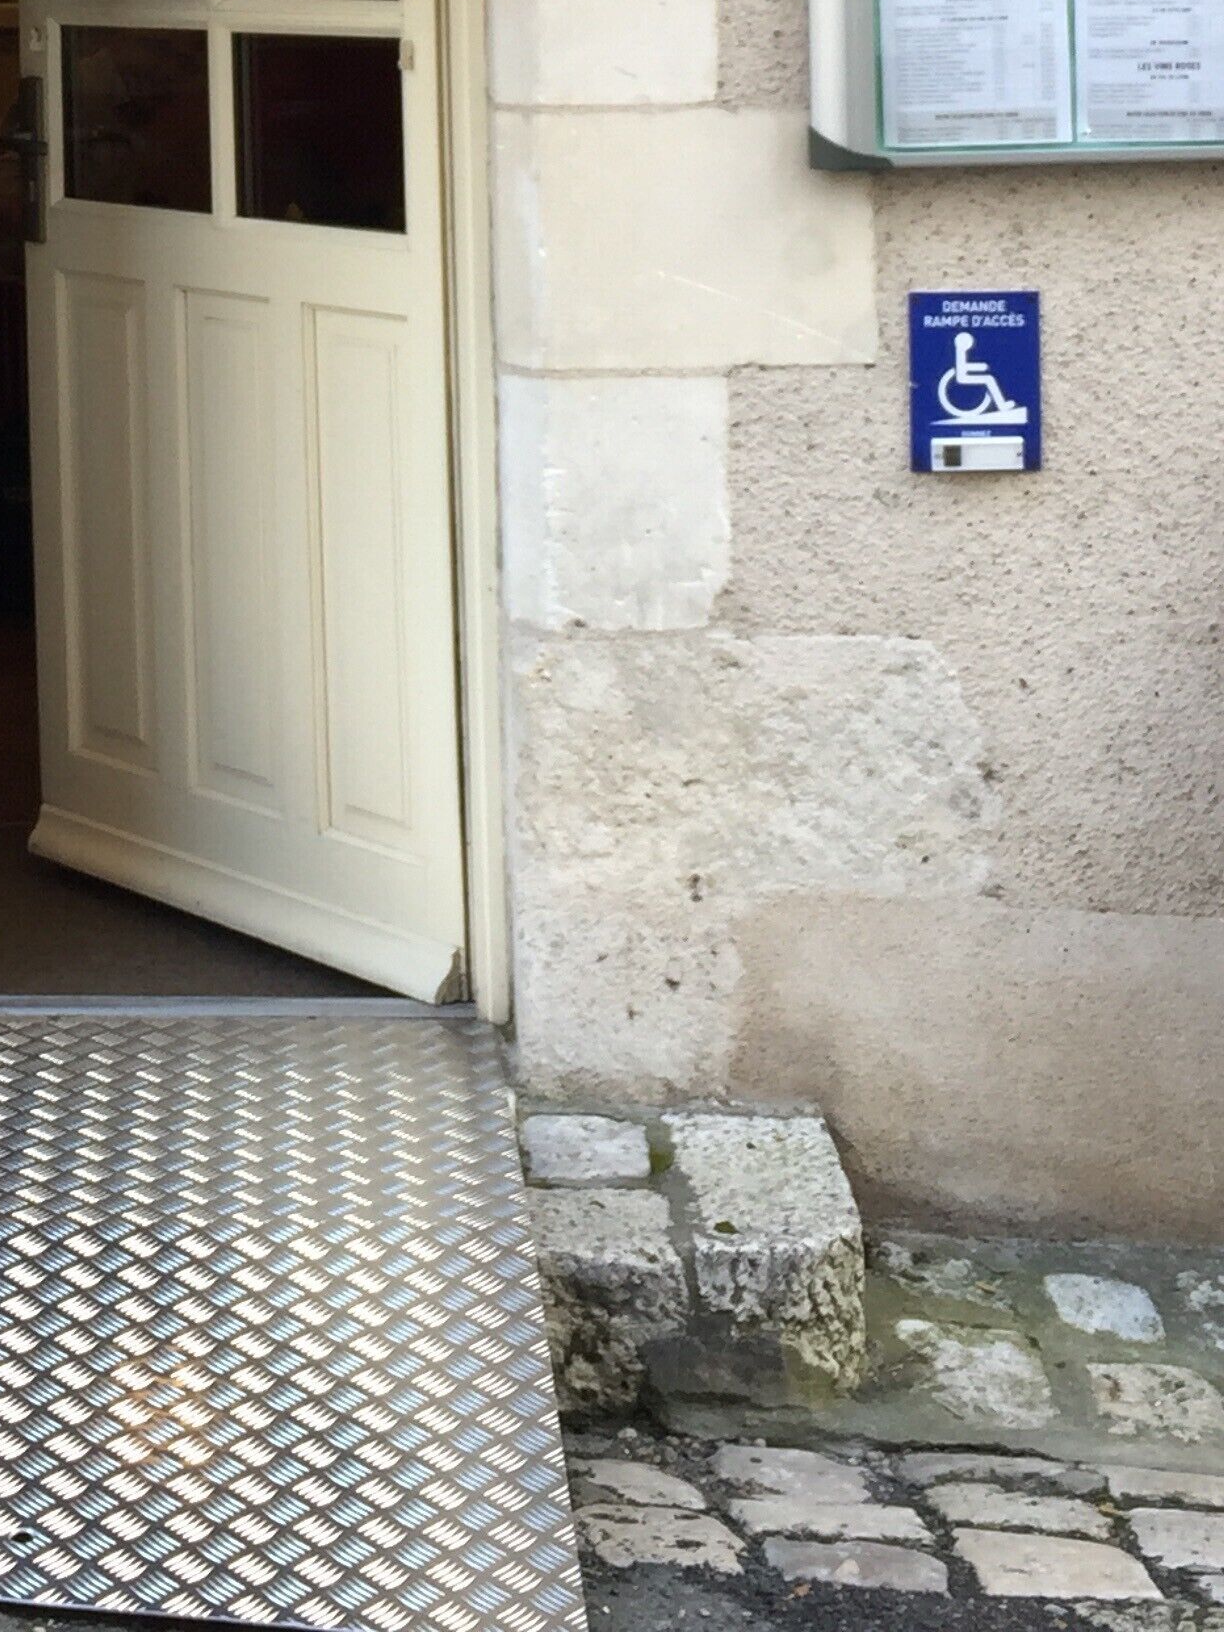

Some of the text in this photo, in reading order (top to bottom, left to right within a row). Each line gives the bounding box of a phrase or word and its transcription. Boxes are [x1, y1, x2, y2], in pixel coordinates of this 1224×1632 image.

[941, 300, 1007, 314] DEMANDE
[923, 312, 1026, 329] RAMPE D'ACCÈS
